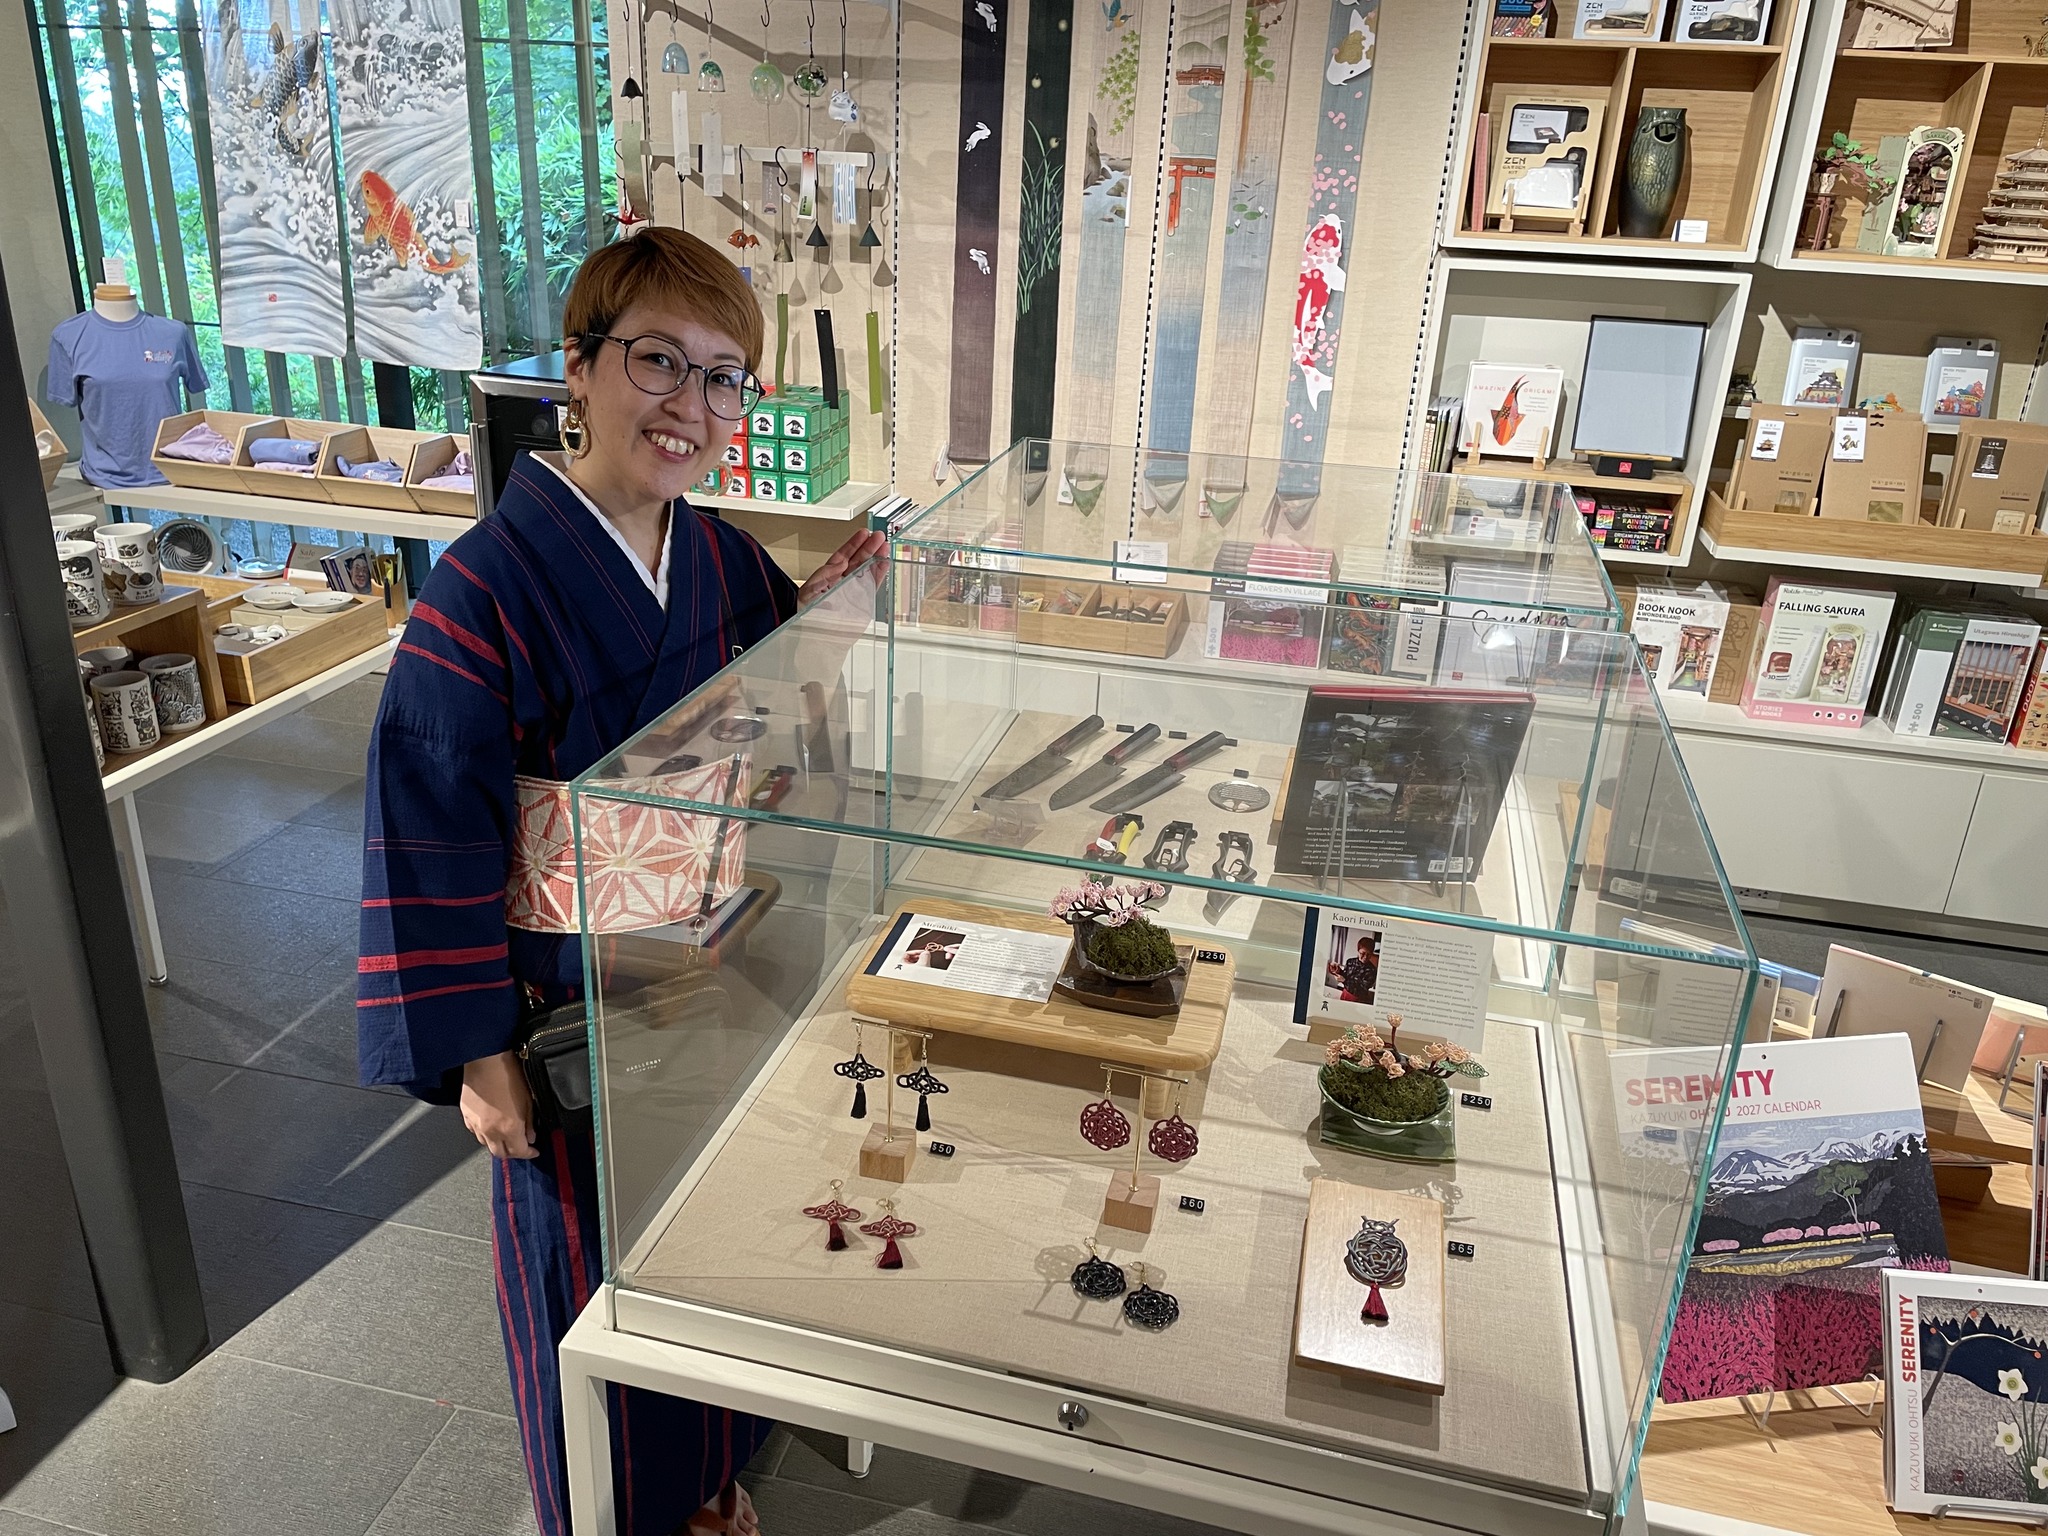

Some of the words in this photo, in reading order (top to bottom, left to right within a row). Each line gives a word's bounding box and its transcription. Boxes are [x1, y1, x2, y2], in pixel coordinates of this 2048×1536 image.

[1504, 157, 1526, 165] ZEN
[1622, 519, 1656, 527] RAINBOW
[1614, 538, 1648, 546] RAINBOW
[1248, 583, 1283, 593] FLOWERS
[1293, 588, 1323, 597] VILLAGE
[1638, 602, 1666, 613] BOOK
[1667, 606, 1697, 617] NOOK
[1778, 601, 1822, 613] FALLING
[1823, 605, 1866, 617] SAKURA
[1641, 612, 1682, 621] WONDERLAND
[1406, 616, 1424, 661] PUZZLE
[1973, 628, 2000, 636] Utagawa
[2001, 631, 2030, 639] Hiroshige
[1754, 704, 1783, 712] STORIES
[1914, 703, 1924, 720] 500
[1332, 912, 1357, 924] Kaori
[1359, 916, 1389, 928] Funaki
[1199, 951, 1225, 961] $250
[1625, 1068, 1775, 1107] SERENITY
[1463, 1094, 1491, 1106] $250
[1630, 1111, 1687, 1125] KAZUYUKI
[1737, 1104, 1761, 1117] 2027
[1764, 1099, 1822, 1115] CALENDAR
[931, 1142, 952, 1155] $50
[1181, 1197, 1204, 1210] $60
[1450, 1242, 1473, 1255] $65
[1898, 1294, 1916, 1383] SERENITY
[1908, 1389, 1920, 1428] OHTSU
[1909, 1431, 1920, 1492] KAZUYUKI
